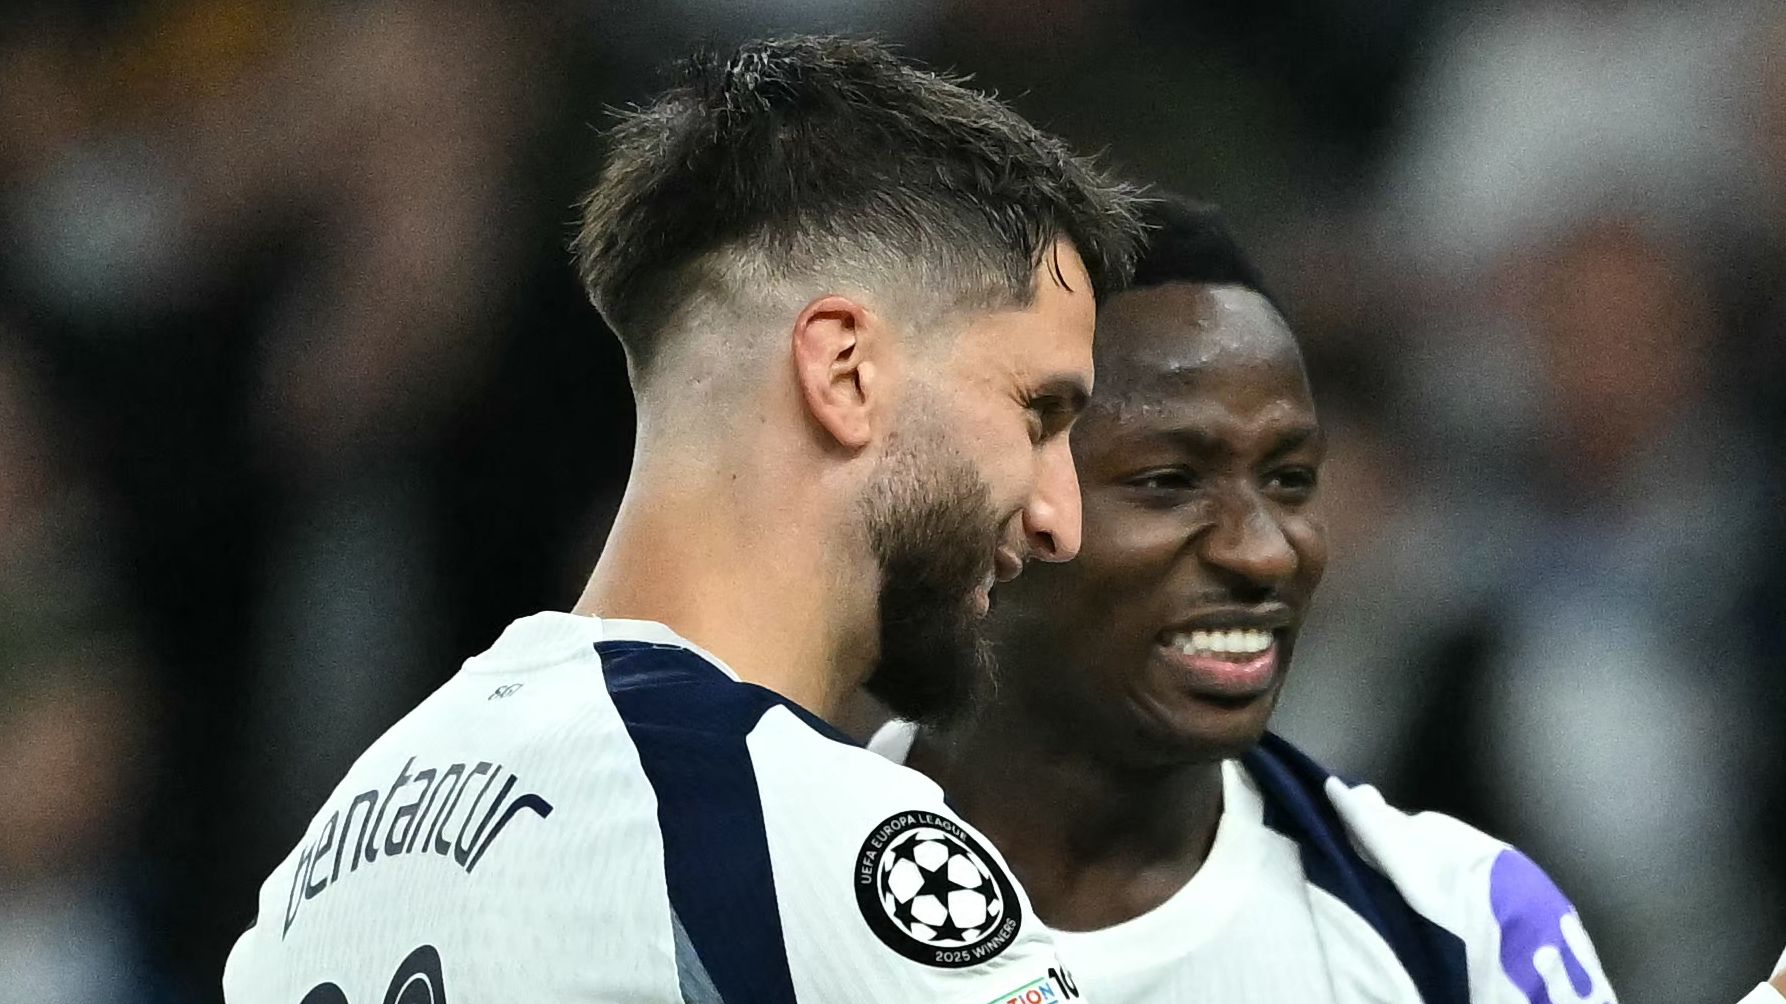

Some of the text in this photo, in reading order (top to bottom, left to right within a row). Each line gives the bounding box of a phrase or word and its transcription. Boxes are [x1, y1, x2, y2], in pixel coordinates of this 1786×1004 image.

[860, 813, 968, 885] UEFA EUROPA LEAGUE
[935, 917, 1017, 963] 2025 WINNERS
